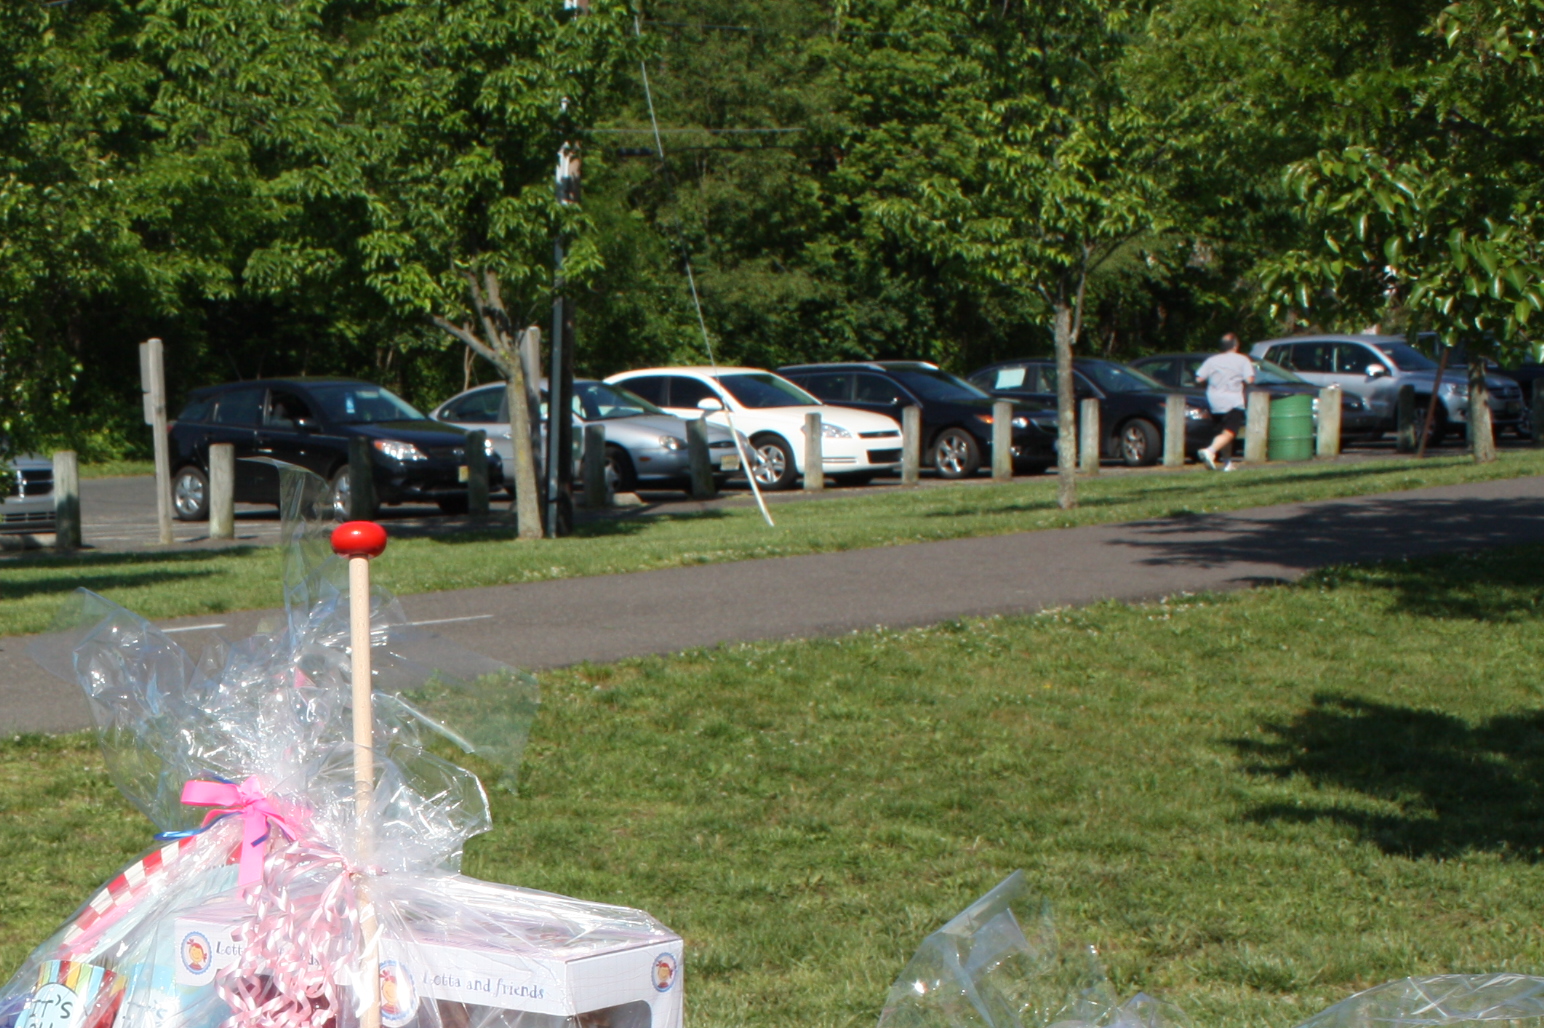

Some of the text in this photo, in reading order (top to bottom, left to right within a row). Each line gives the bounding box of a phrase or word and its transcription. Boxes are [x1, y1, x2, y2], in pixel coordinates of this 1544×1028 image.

[216, 941, 243, 956] Lott
[466, 978, 491, 993] and
[494, 977, 545, 999] friends
